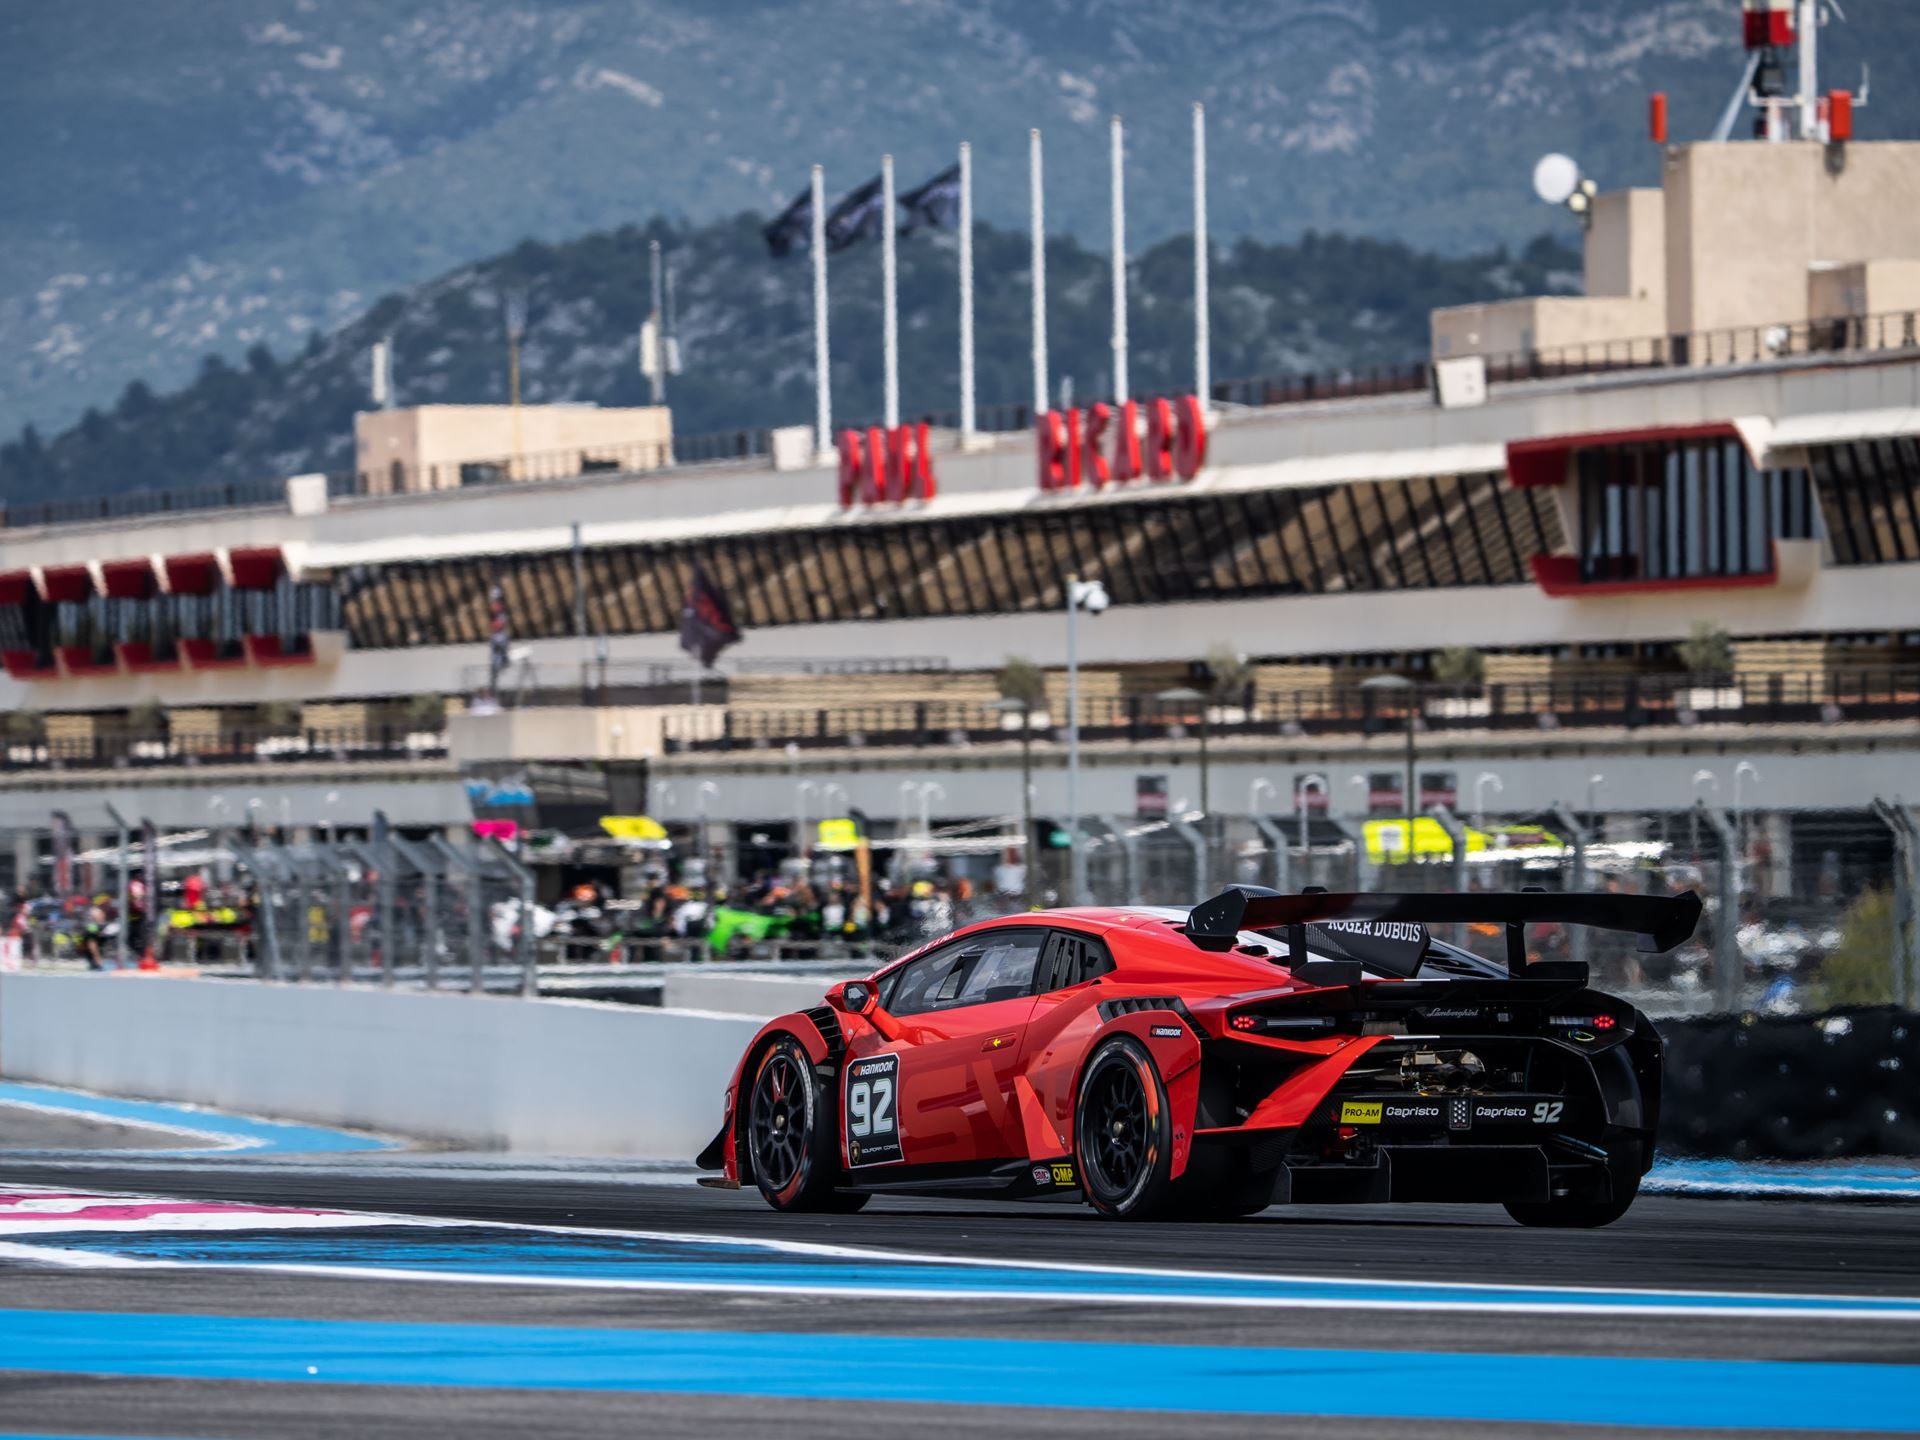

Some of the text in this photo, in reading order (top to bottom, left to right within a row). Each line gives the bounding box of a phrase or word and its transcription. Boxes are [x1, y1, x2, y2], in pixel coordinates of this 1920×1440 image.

[1373, 921, 1421, 943] DUBUIS
[1426, 1007, 1479, 1018] Lamborghini
[850, 1078, 894, 1137] 92
[1344, 1108, 1380, 1117] PRO-AM
[1386, 1106, 1440, 1118] Capristo
[1476, 1106, 1527, 1118] Capristo
[1532, 1101, 1564, 1124] 92
[1052, 1167, 1074, 1182] OMP
